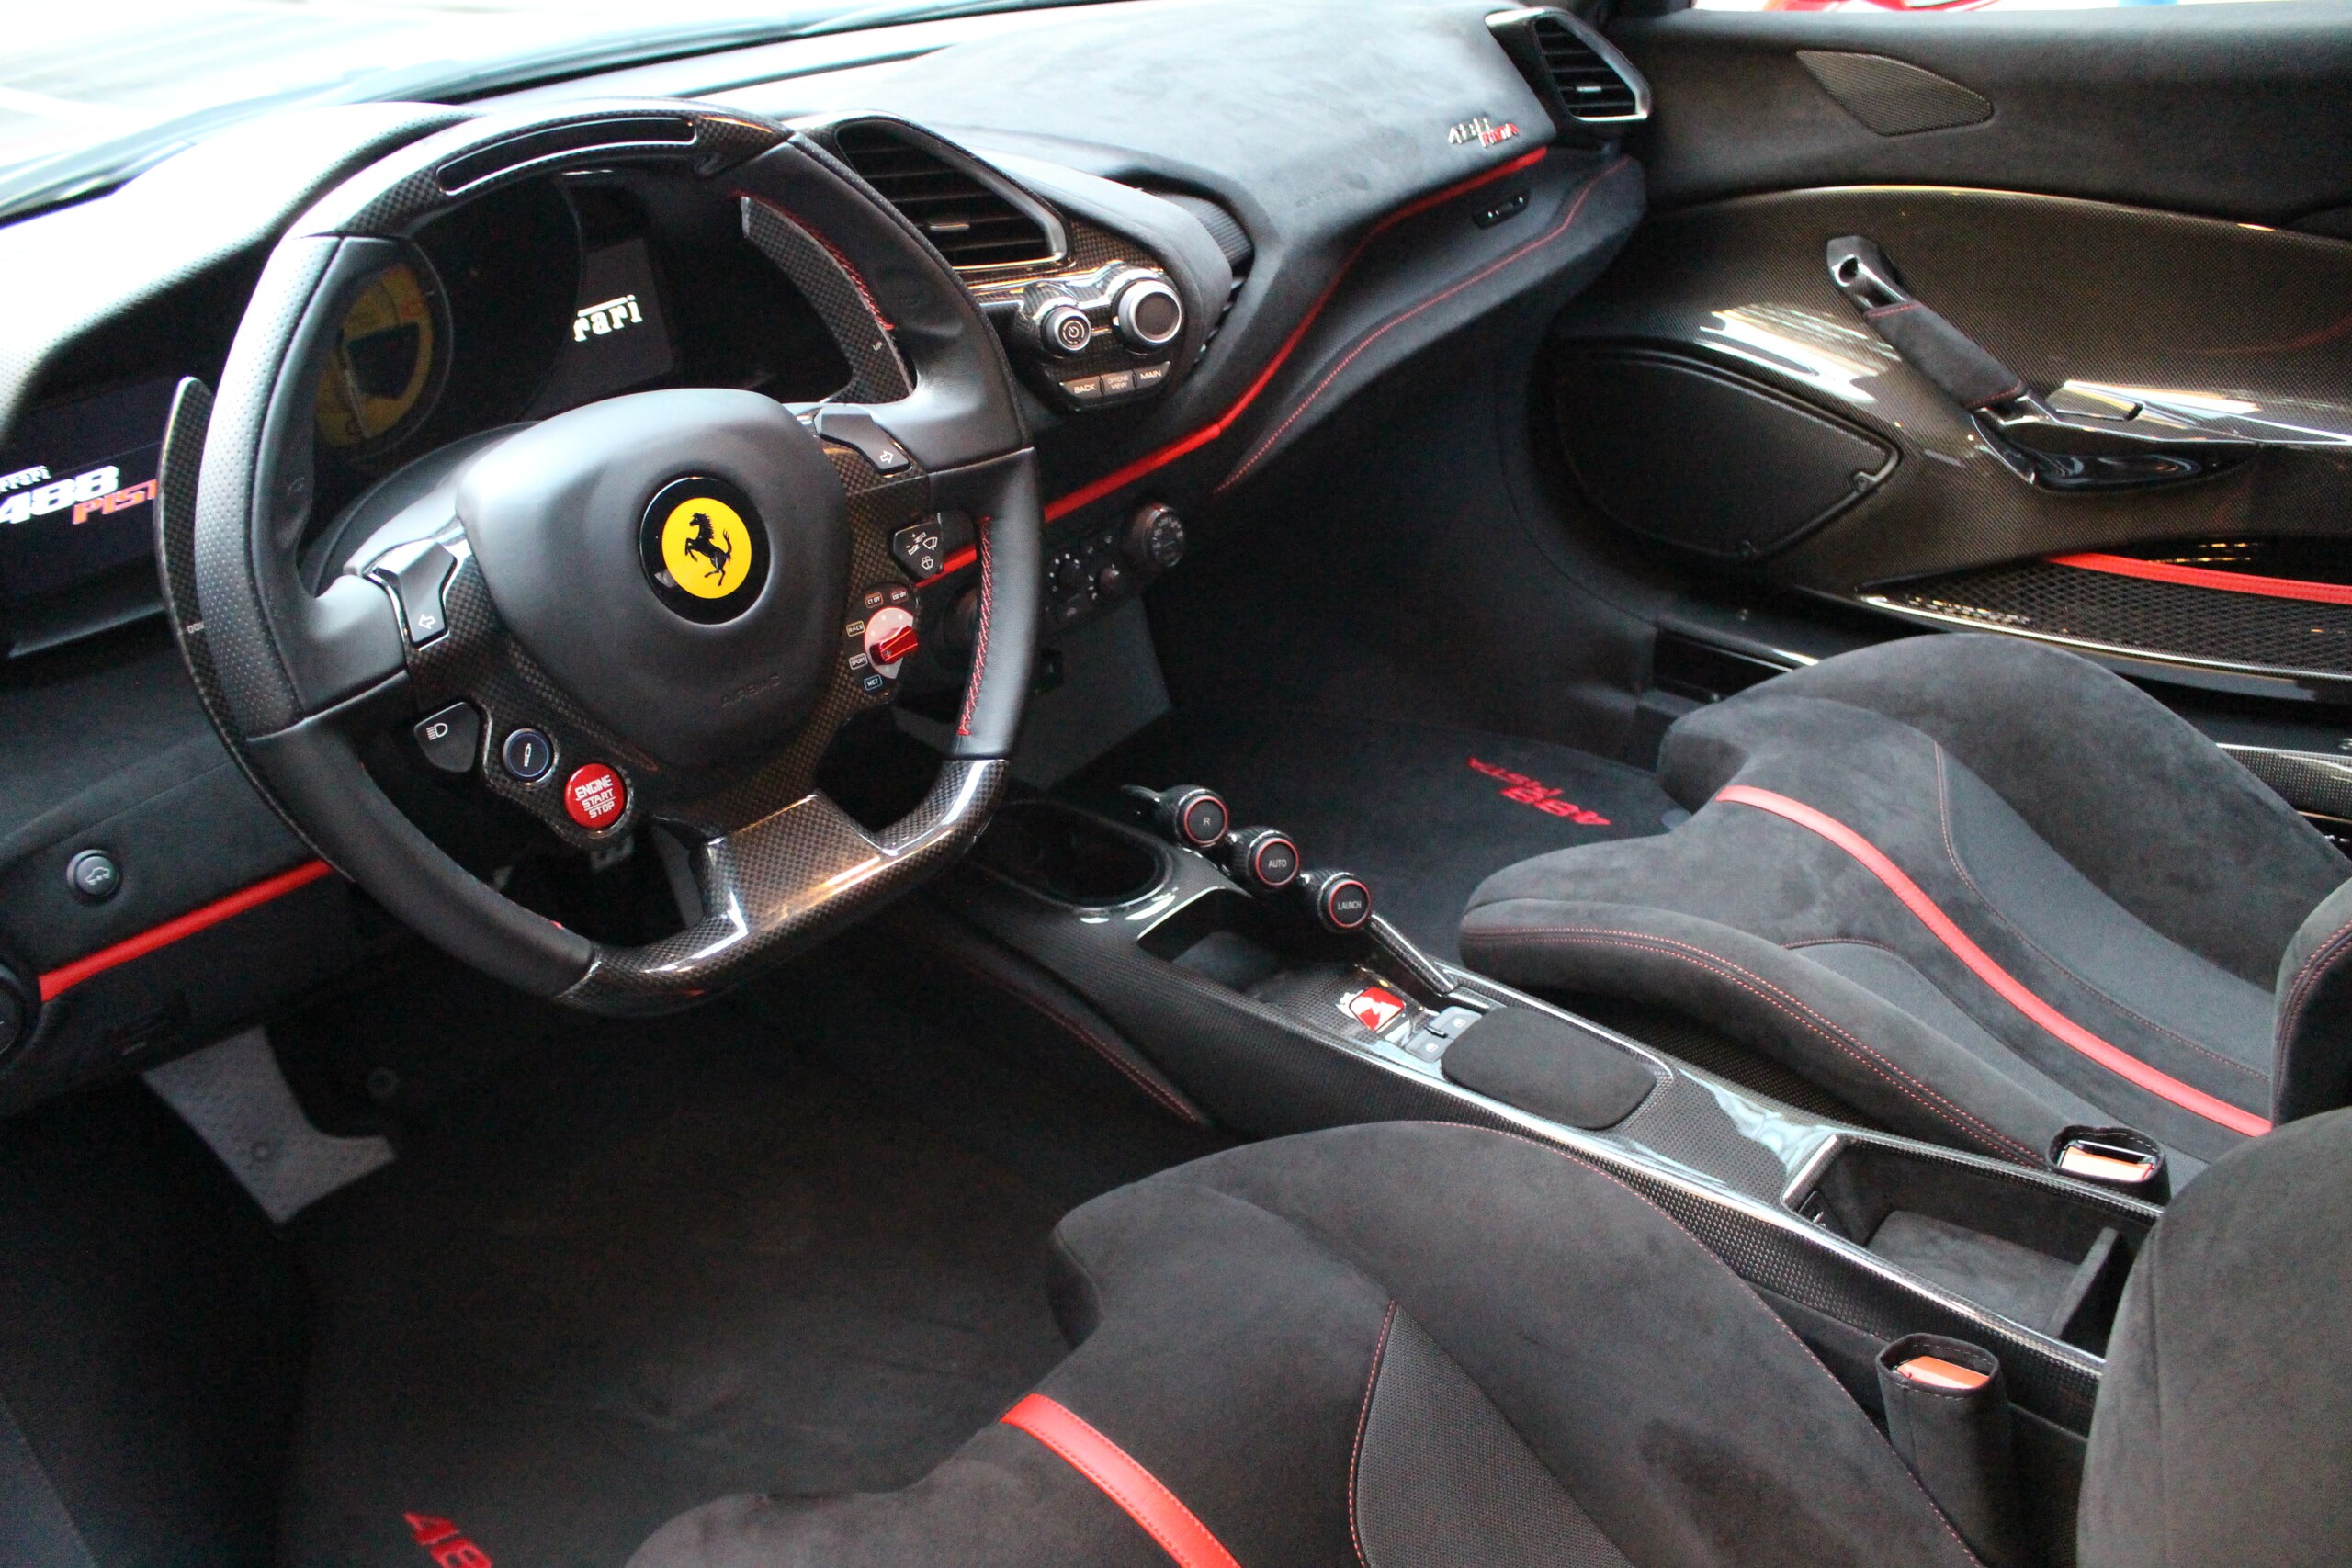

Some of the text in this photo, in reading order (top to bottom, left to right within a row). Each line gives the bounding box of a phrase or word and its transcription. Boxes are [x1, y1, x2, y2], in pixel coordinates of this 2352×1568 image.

[573, 294, 643, 342] rari
[872, 341, 883, 351] UP
[1139, 369, 1162, 380] MAIN
[1073, 383, 1096, 394] BACK
[0, 465, 119, 525] 488
[848, 625, 864, 633] RACE
[851, 657, 865, 666] SPORT
[866, 678, 879, 686] WET
[574, 774, 614, 801] ENGINE
[582, 788, 615, 809] START
[589, 800, 616, 819] STOP
[1203, 817, 1211, 826] R
[1268, 858, 1287, 869] AUTO
[1338, 900, 1362, 910] LAUNCH
